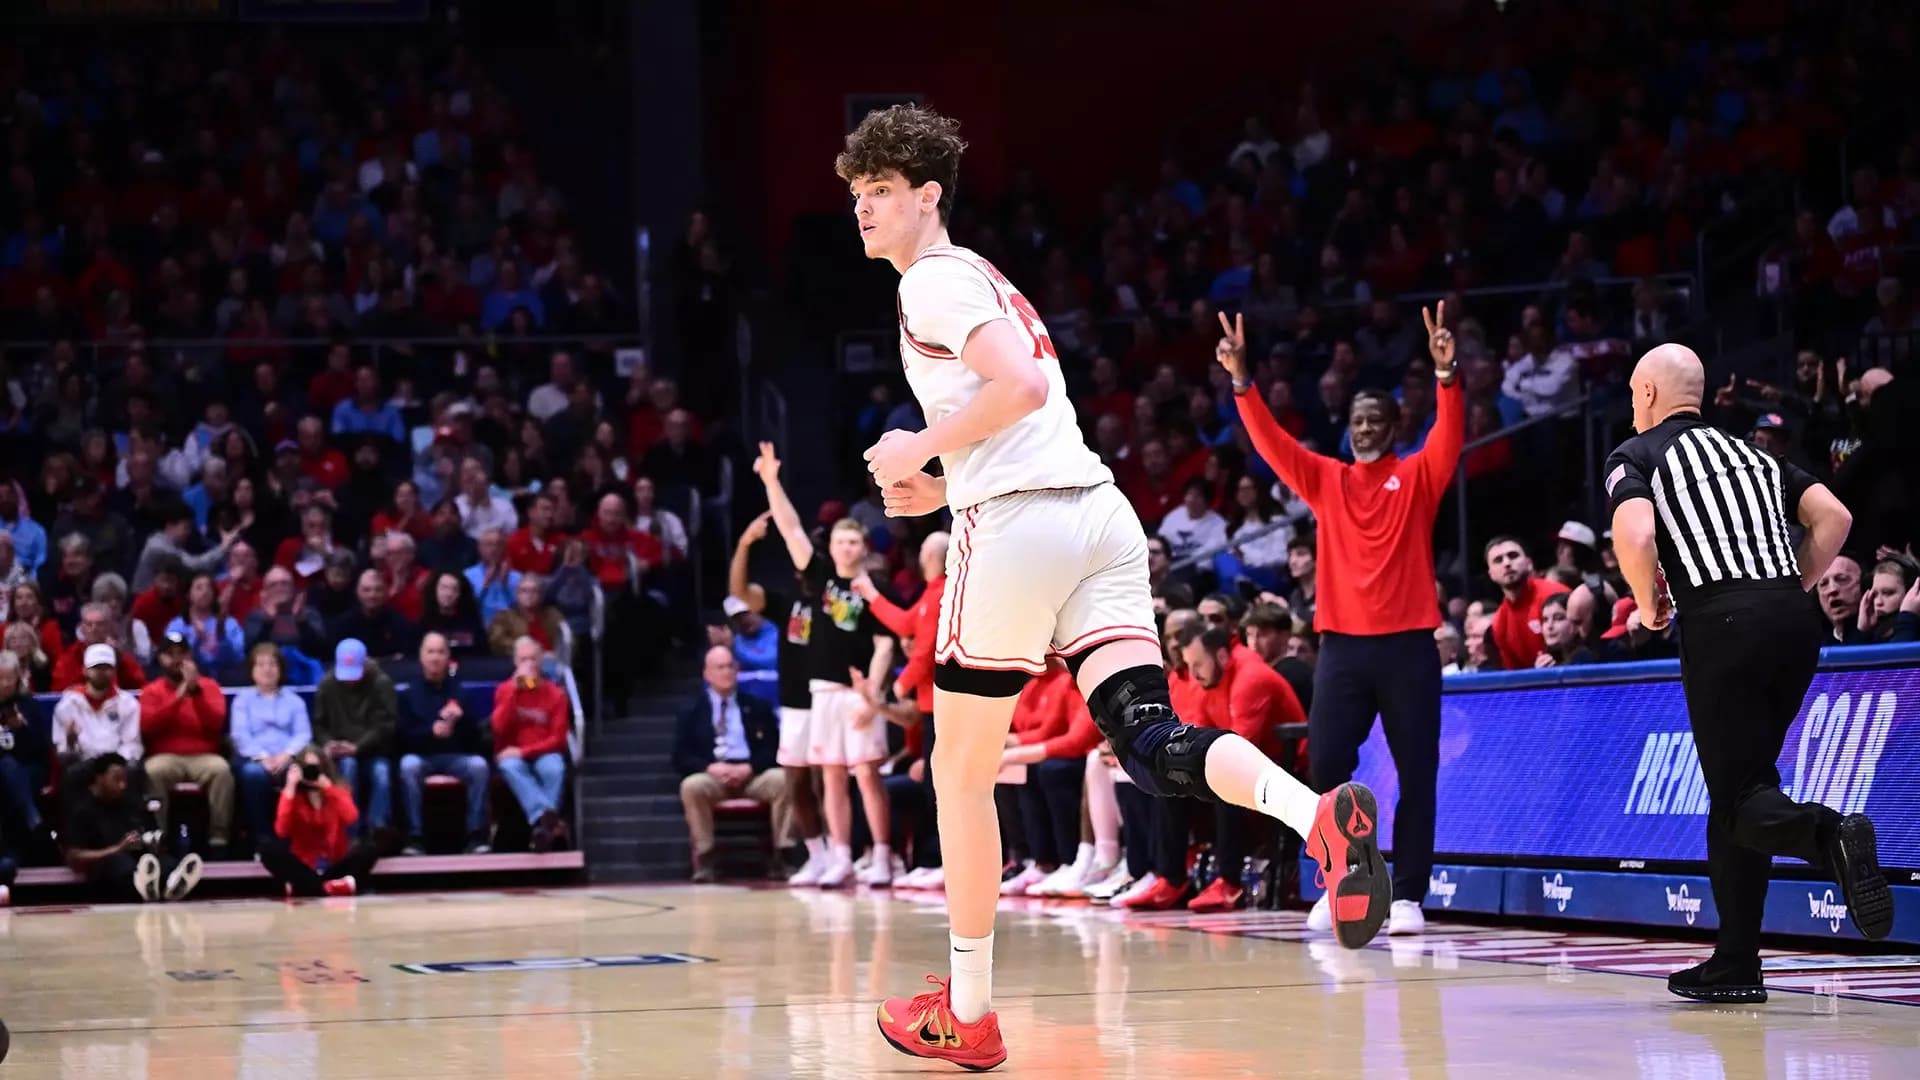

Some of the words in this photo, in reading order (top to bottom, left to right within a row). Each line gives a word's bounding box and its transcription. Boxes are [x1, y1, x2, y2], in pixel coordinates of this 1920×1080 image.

[1781, 690, 1898, 815] SOAR
[1552, 873, 1574, 912] Kroger
[1678, 883, 1702, 925] Kroger
[1820, 889, 1848, 934] Kroger
